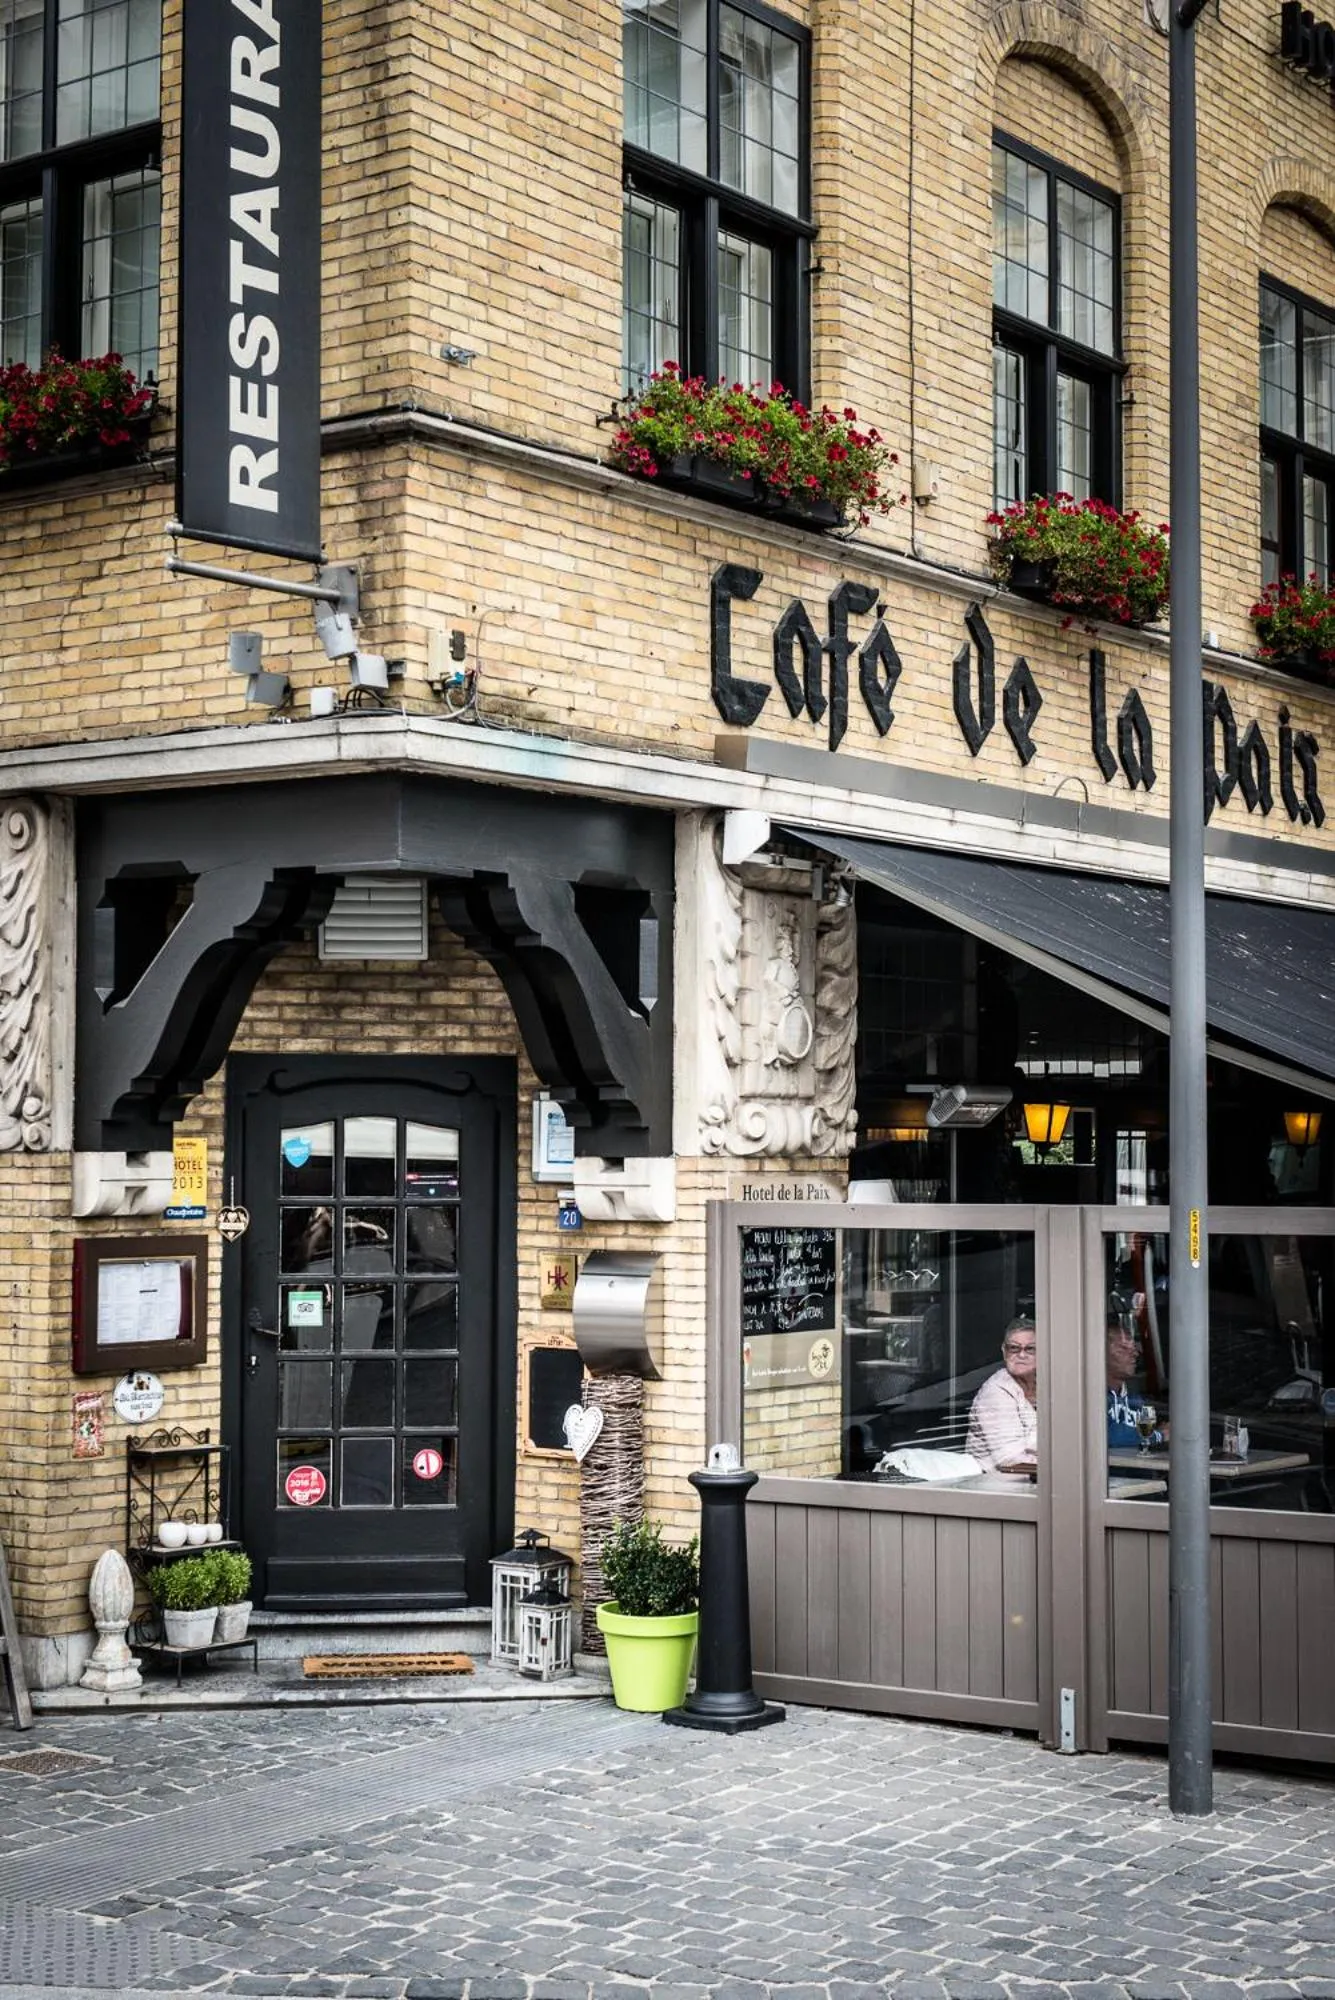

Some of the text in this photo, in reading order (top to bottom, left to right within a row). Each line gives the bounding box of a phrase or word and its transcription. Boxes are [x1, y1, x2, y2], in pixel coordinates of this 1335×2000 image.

[711, 563, 902, 752] Café
[1086, 649, 1156, 792] la
[172, 1177, 203, 1189] 2013
[742, 1184, 831, 1200] Hotel de la Paix
[563, 1211, 577, 1225] 20
[322, 1660, 456, 1668] WELCOME
